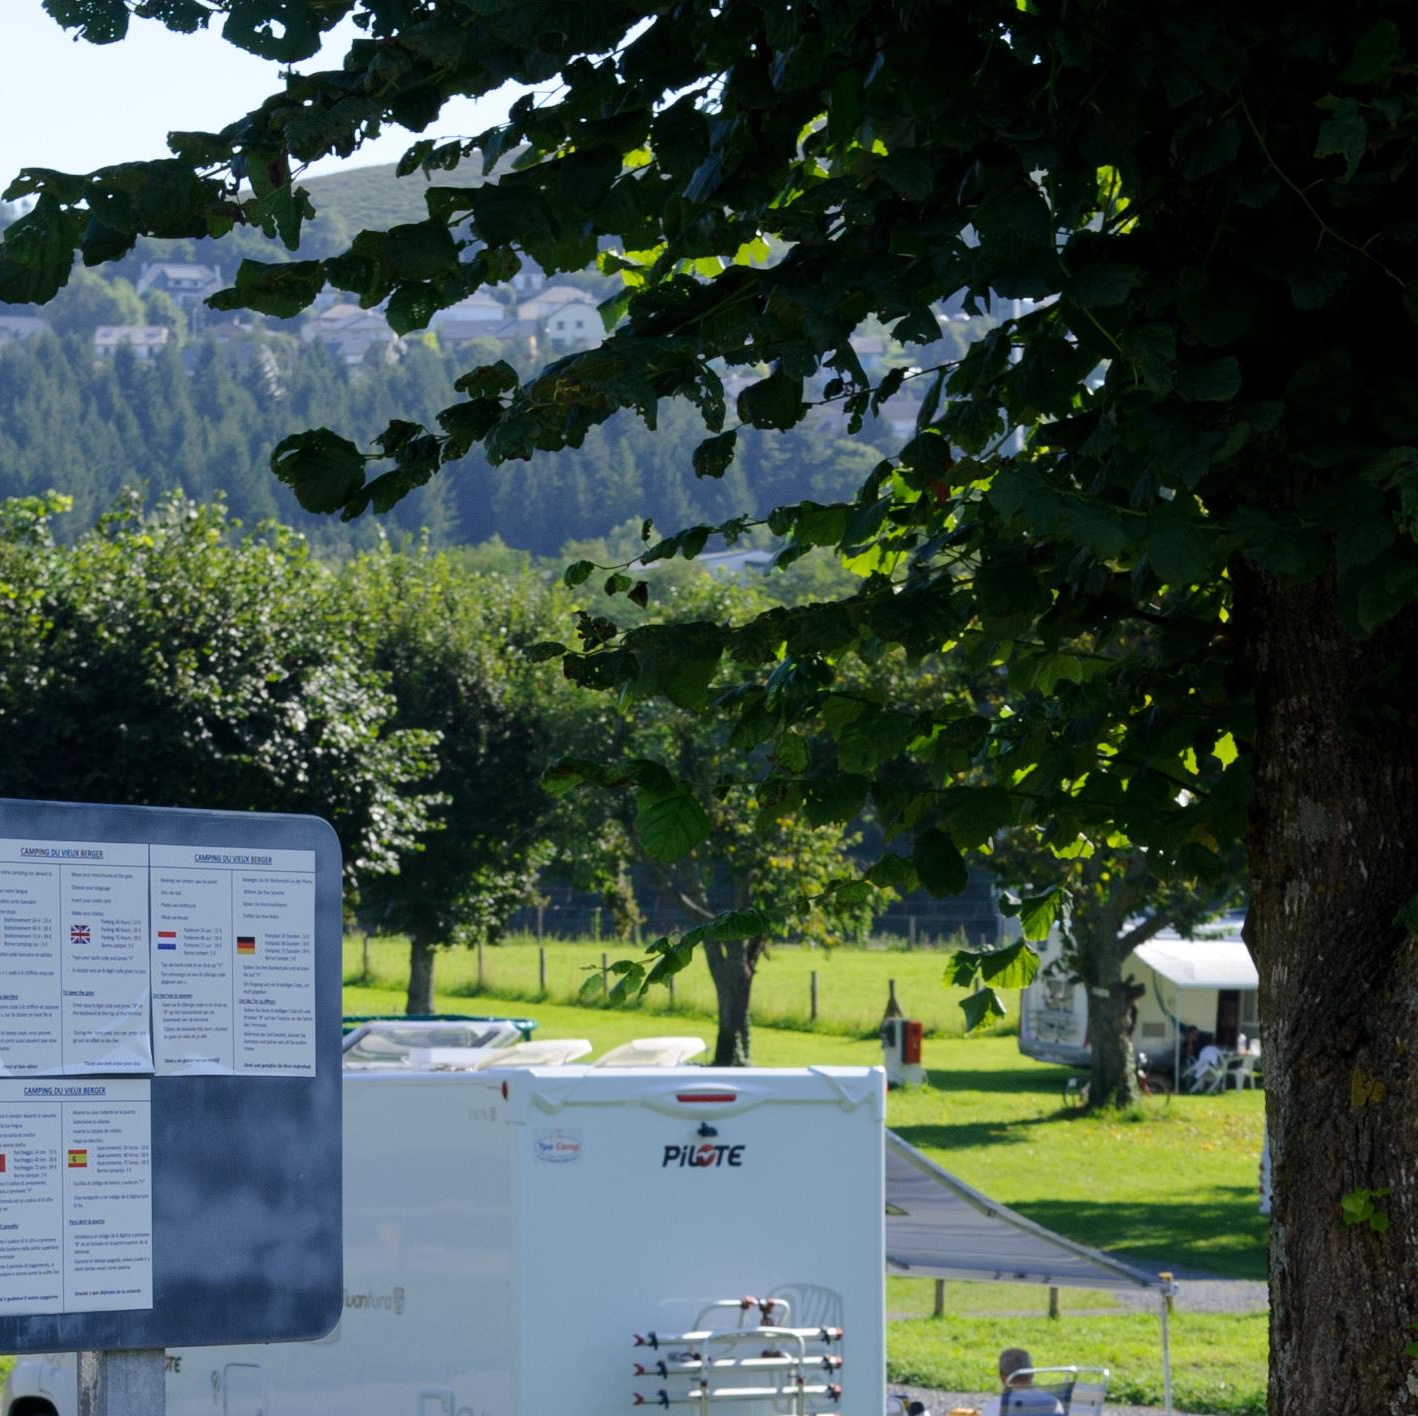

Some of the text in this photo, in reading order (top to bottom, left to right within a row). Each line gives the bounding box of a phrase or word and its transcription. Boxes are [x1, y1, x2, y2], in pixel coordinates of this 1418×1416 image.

[21, 847, 104, 859] CAMPING DU VIEUX BERGER
[195, 854, 221, 863] CAMPING
[222, 855, 231, 863] DU
[232, 855, 250, 864] VIEUX
[24, 1087, 106, 1096] CAMPING DU VIEUX BERGER
